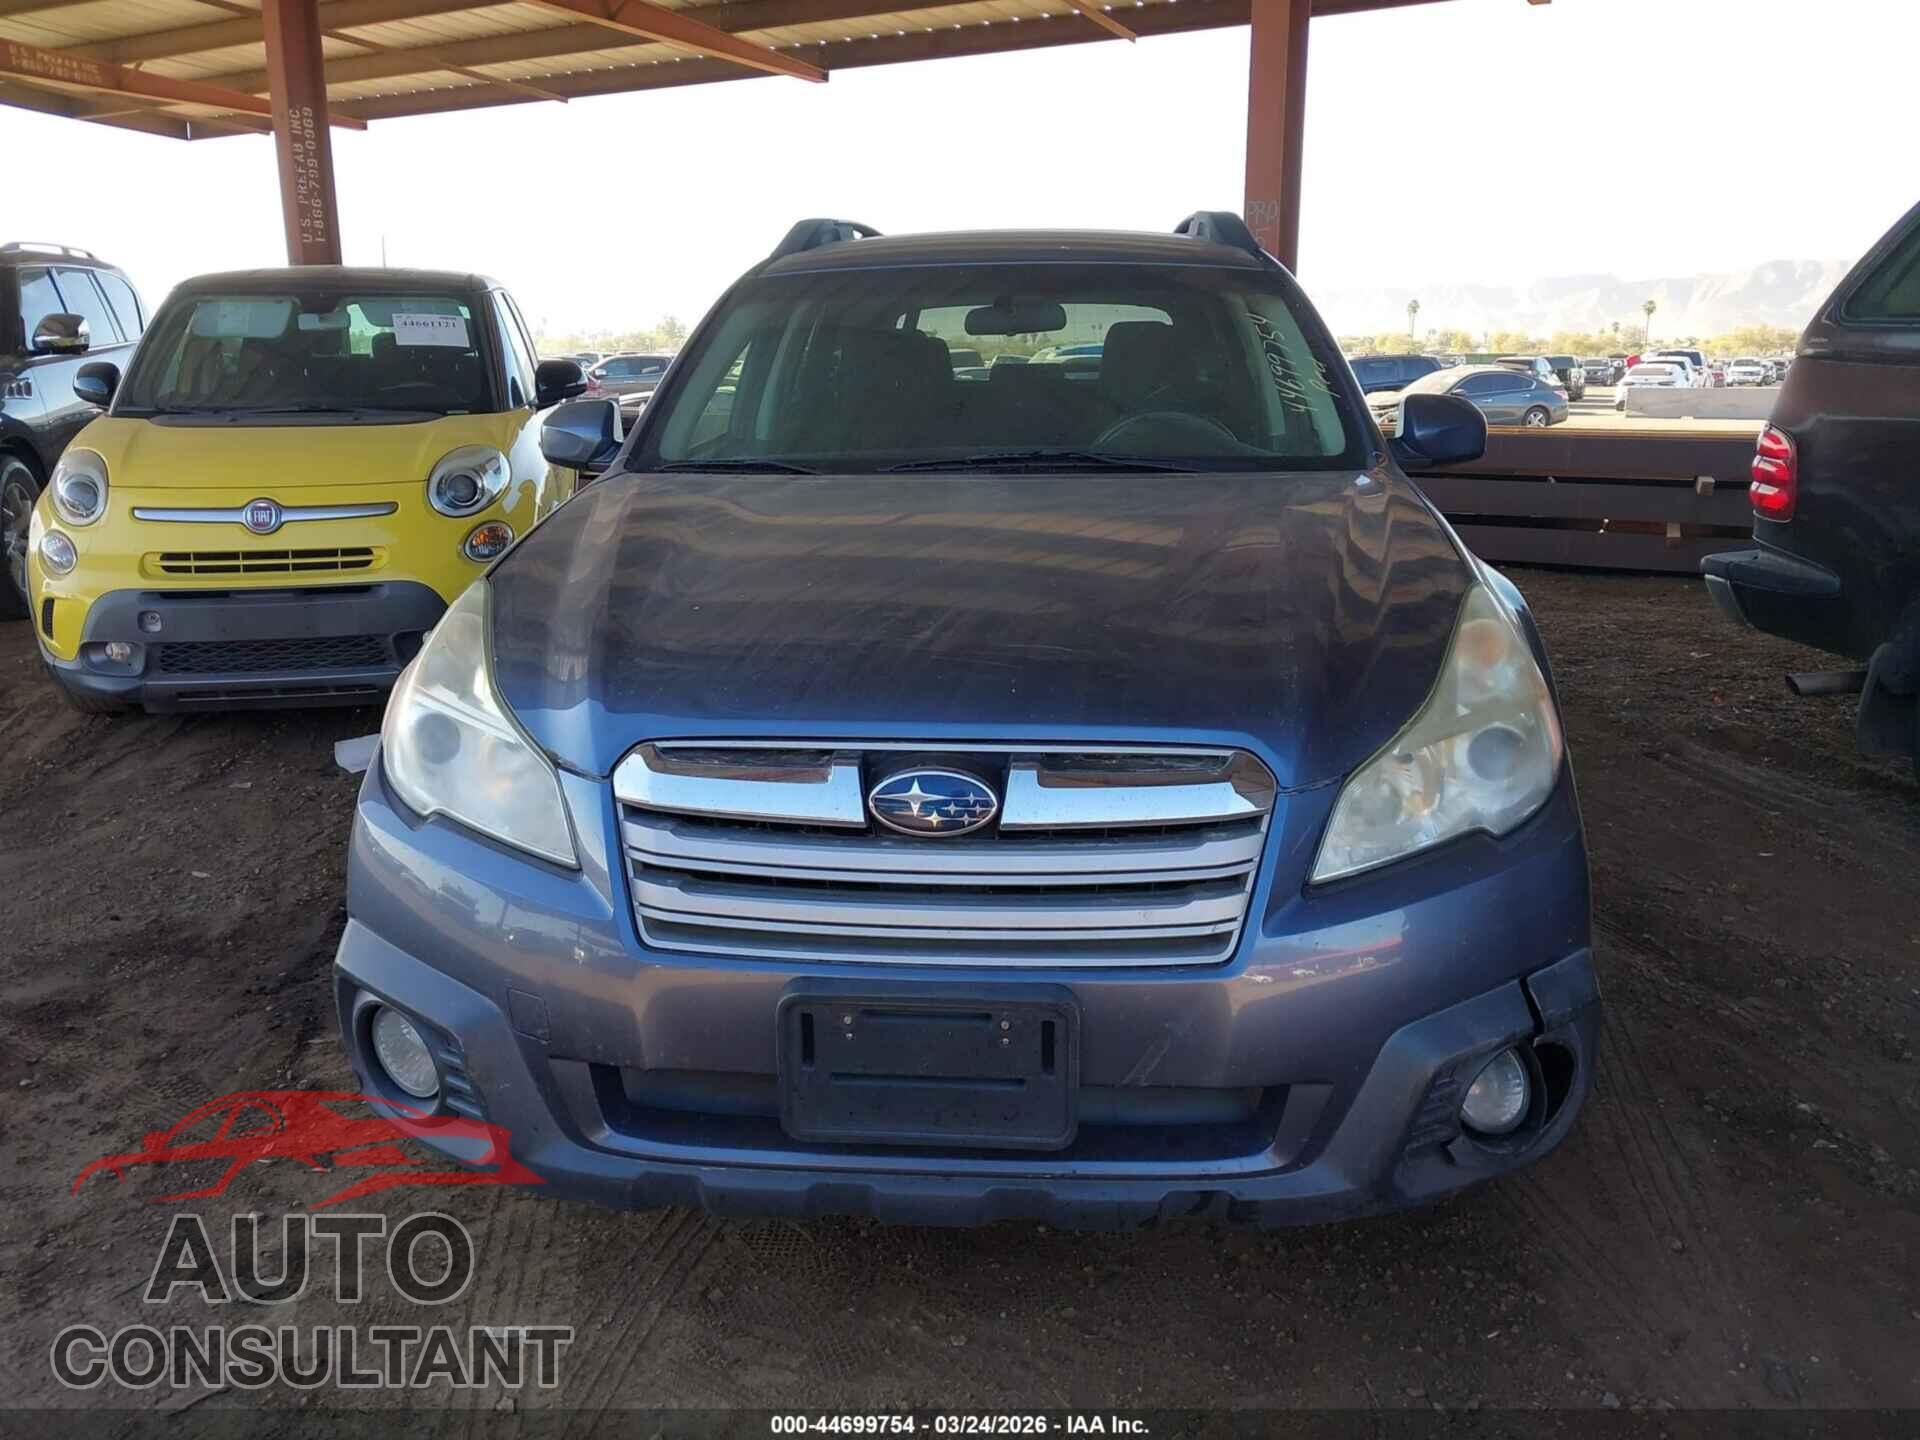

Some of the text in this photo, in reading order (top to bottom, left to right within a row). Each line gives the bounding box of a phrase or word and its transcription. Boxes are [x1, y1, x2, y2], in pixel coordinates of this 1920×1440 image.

[293, 143, 309, 205] PREFAB
[1245, 312, 1320, 412] 44699754
[253, 510, 271, 523] FIAT
